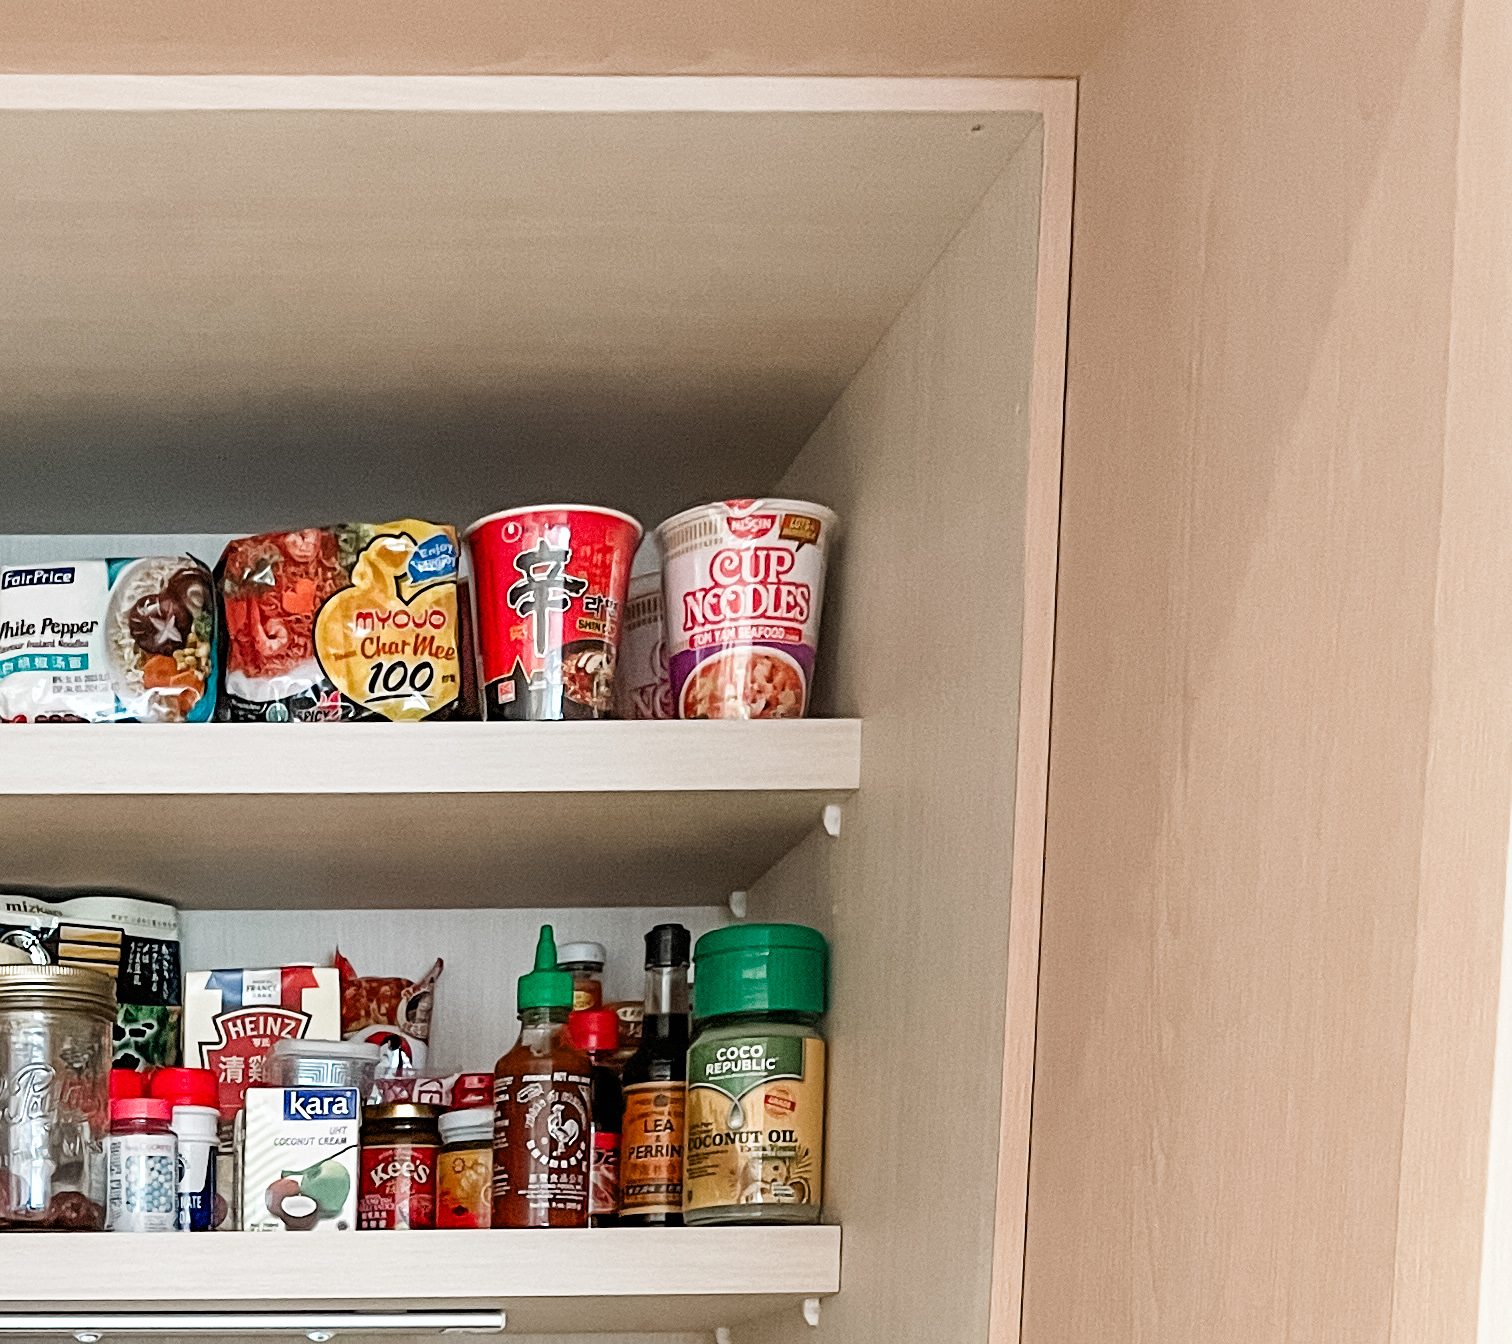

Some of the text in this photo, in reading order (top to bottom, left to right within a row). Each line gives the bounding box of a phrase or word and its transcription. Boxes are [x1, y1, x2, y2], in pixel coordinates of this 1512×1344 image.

[731, 517, 772, 531] NISSIN
[710, 546, 795, 586] CUP
[3, 569, 73, 588] FairPrice
[683, 582, 811, 632] NOODLES
[40, 617, 99, 639] Pepper
[355, 609, 447, 631] MYOJO
[693, 631, 712, 647] TOM
[368, 660, 435, 694] 100
[227, 1015, 297, 1040] HEINZ
[716, 1044, 764, 1061] COCO
[705, 1058, 777, 1076] REPUBLIC
[290, 1090, 349, 1120] kara
[329, 1125, 348, 1136] UHT
[643, 1119, 675, 1134] LEA
[768, 1129, 798, 1143] OIL
[273, 1137, 316, 1146] COCONUT
[370, 1159, 430, 1188] Kee's
